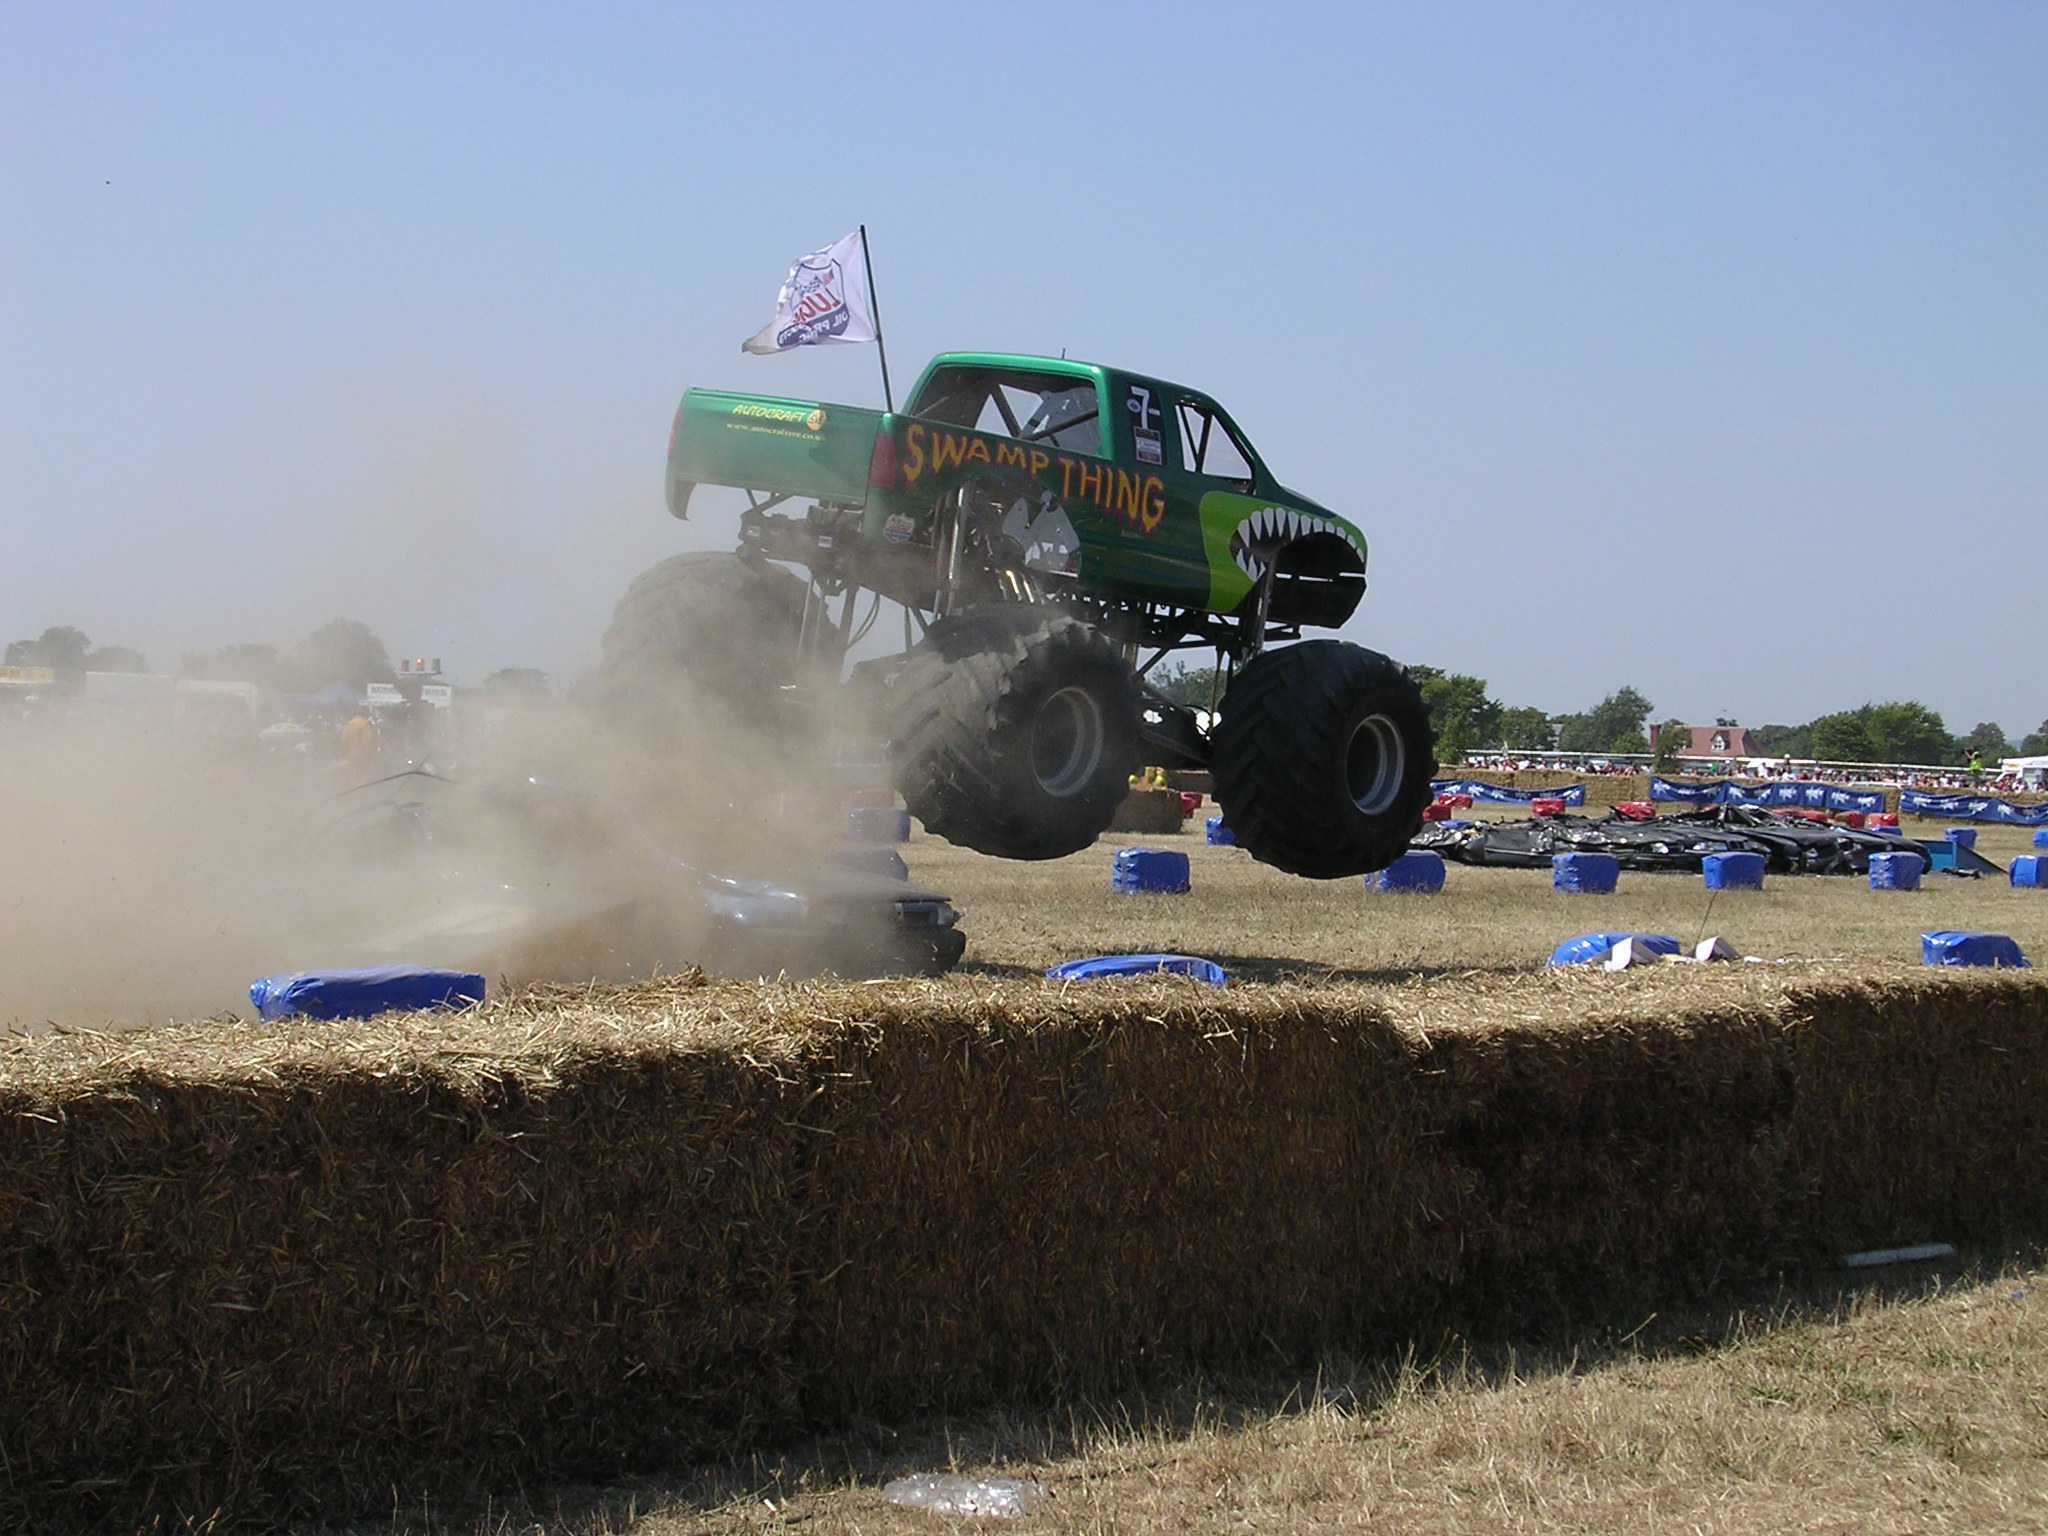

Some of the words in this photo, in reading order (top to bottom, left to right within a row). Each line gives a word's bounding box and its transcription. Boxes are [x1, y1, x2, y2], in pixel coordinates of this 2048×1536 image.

[732, 404, 807, 422] AUTOCRAFT
[1131, 385, 1150, 429] 7
[902, 422, 1050, 485] SWAMP
[1058, 455, 1166, 533] THING
